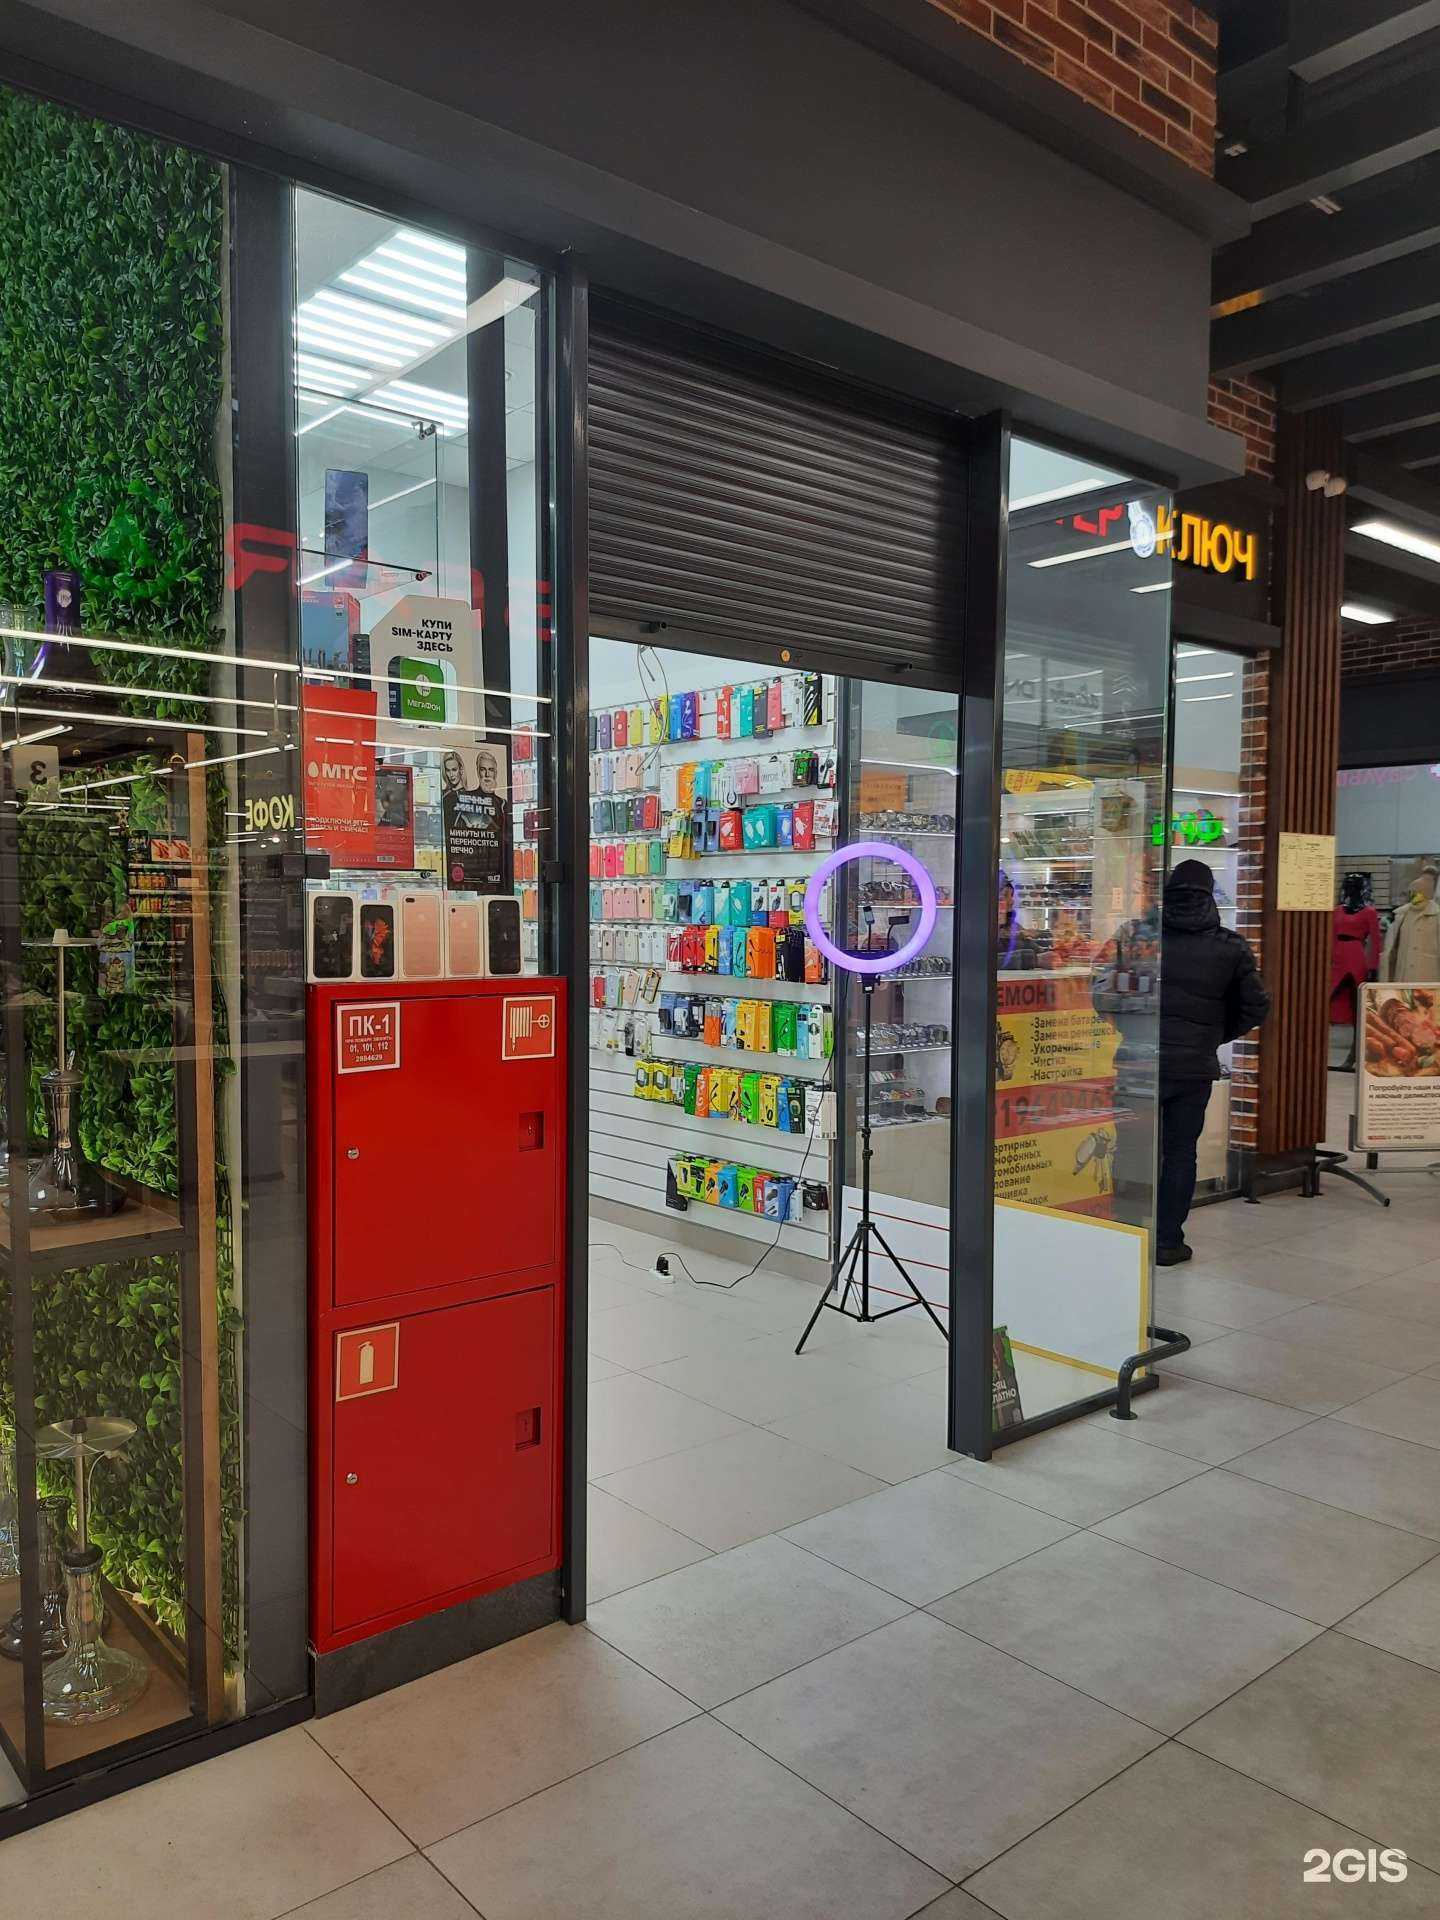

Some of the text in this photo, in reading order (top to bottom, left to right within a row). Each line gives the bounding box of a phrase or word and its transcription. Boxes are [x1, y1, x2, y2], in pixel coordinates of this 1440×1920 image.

[1156, 504, 1255, 581] КЛЮЧ
[421, 619, 452, 630] КУПИ
[391, 627, 453, 641] SIM-КАРТУ
[416, 641, 453, 652] ЗДЕСЬ
[321, 763, 368, 782] МТС
[449, 829, 495, 839] МИНУТЫ И ГБ
[450, 837, 499, 848] ПЕРЕНОСЯТСЯ
[450, 846, 474, 854] ВЕЧНО
[349, 1014, 390, 1037] ПК-1
[377, 1041, 389, 1050] 112
